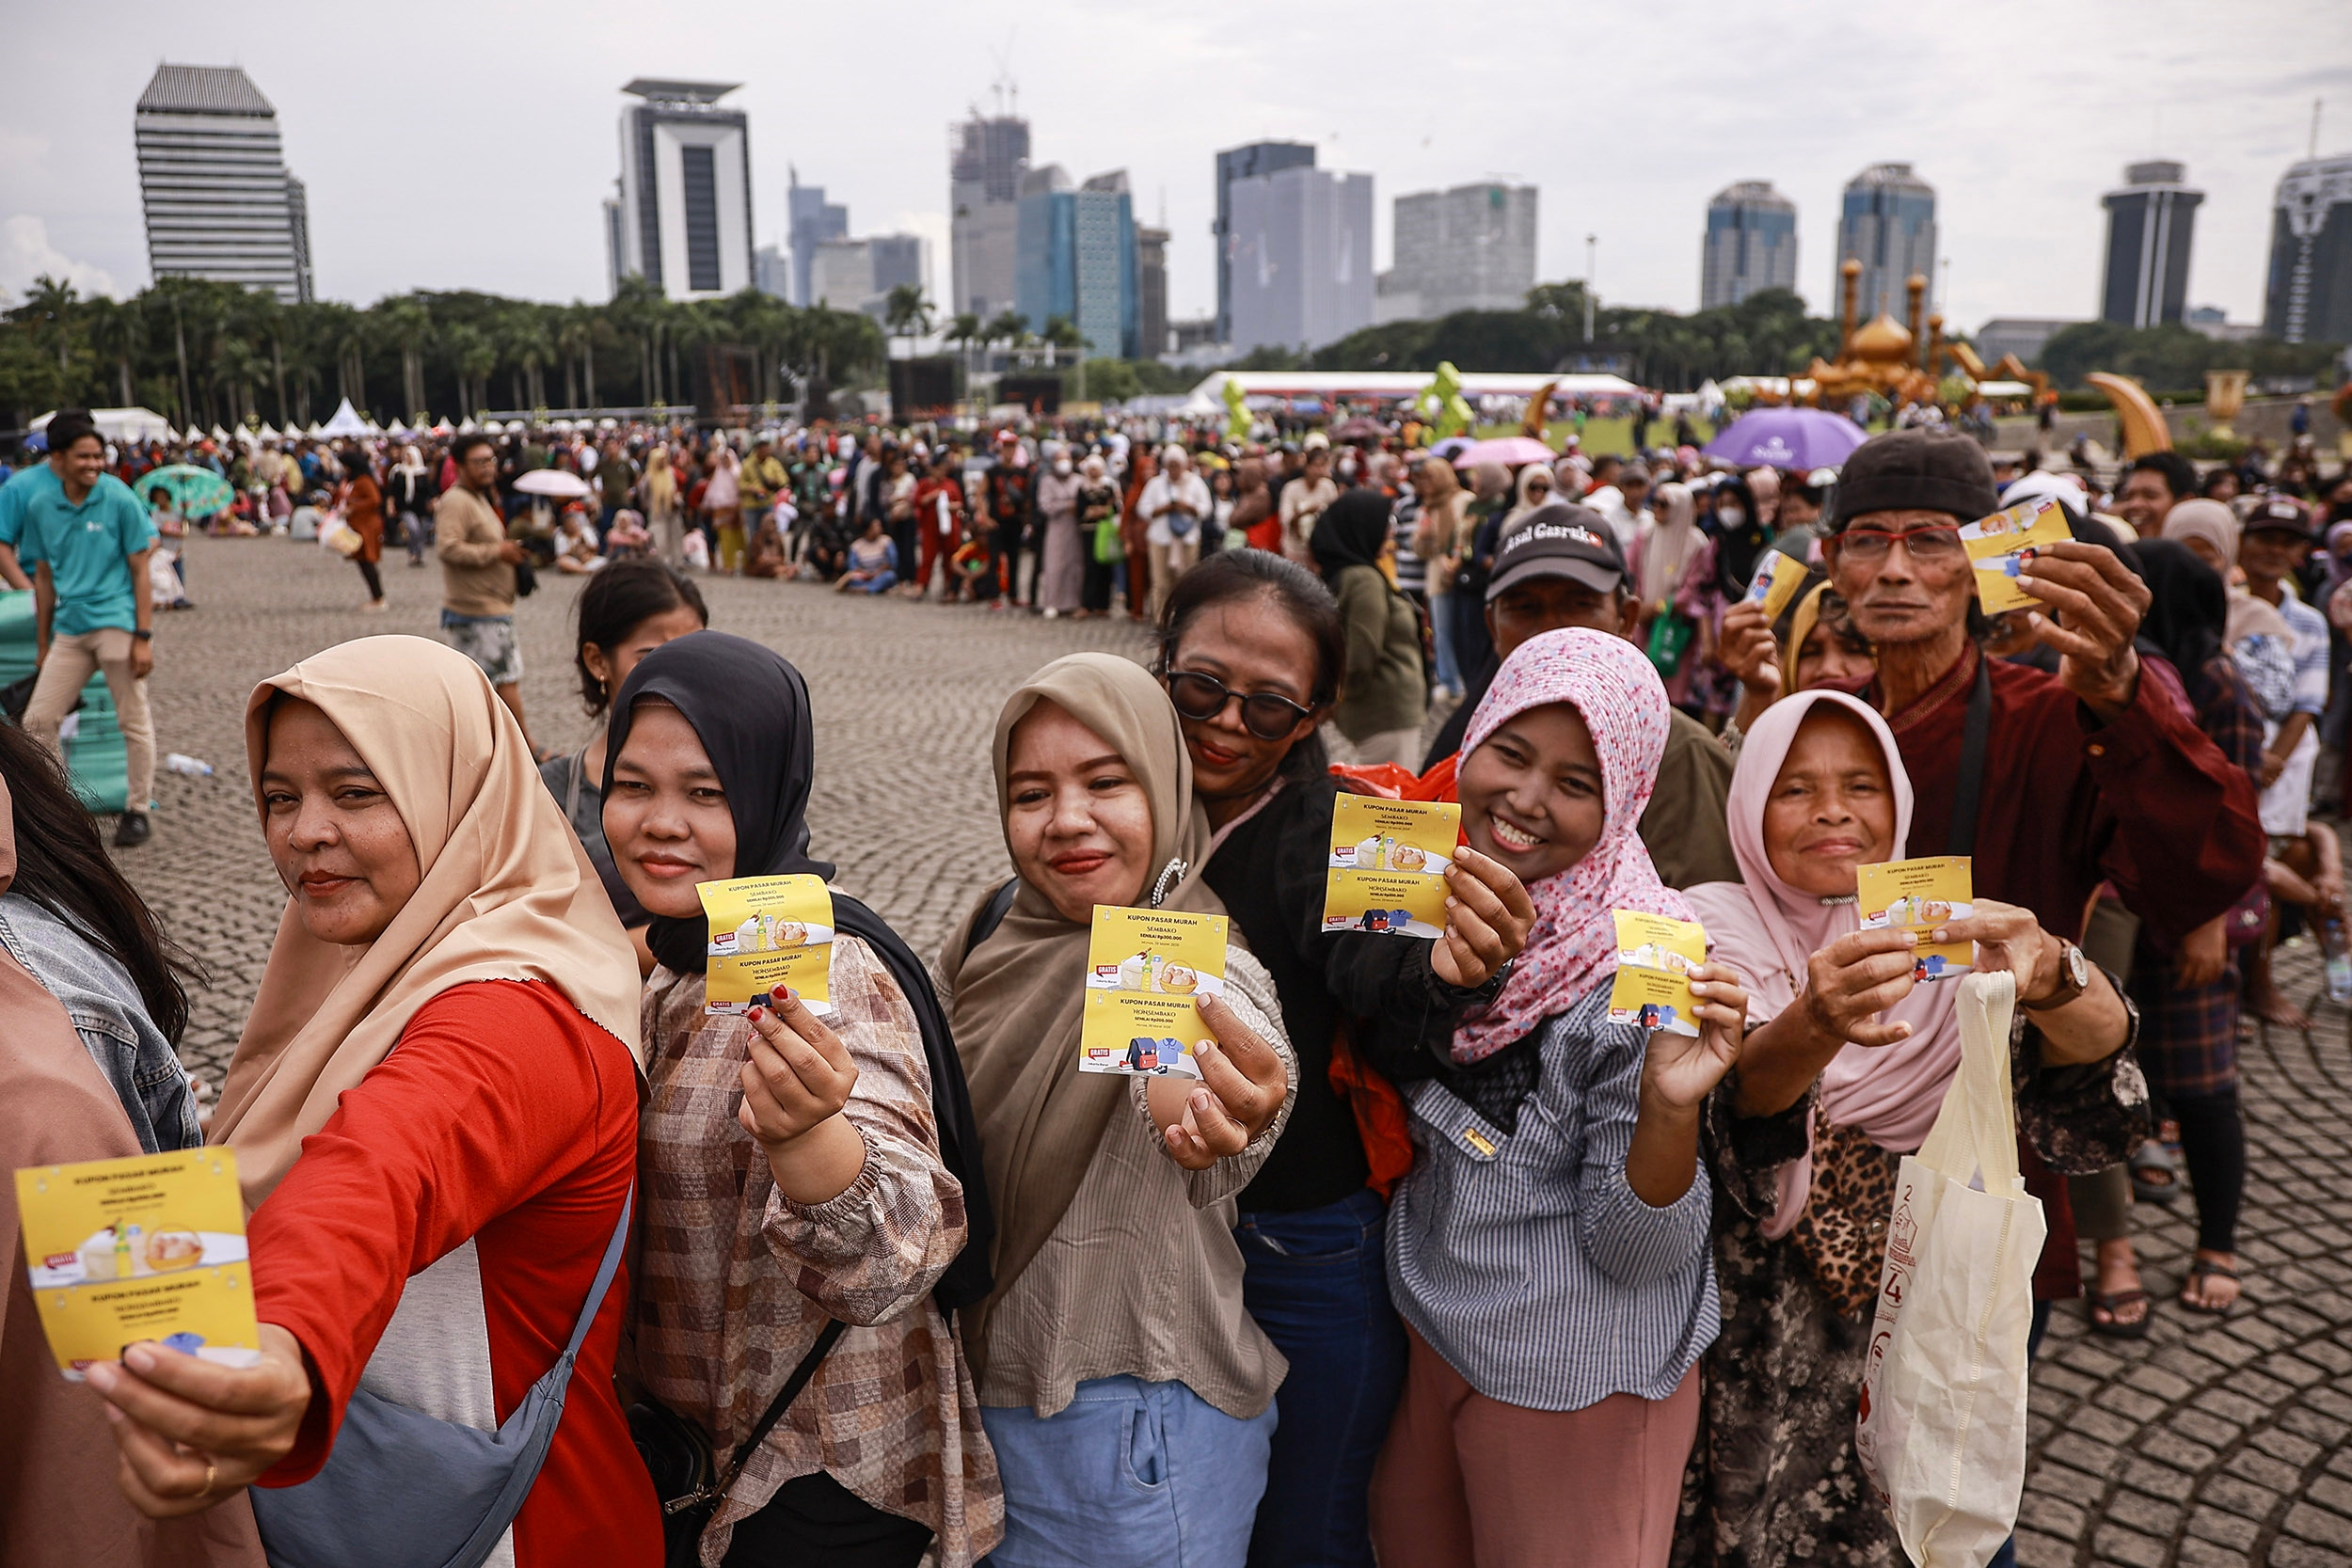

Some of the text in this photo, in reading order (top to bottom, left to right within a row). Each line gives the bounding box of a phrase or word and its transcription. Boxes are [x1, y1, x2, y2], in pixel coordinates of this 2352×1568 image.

[716, 933, 734, 942] GRATIS
[1133, 1008, 1176, 1017] NONSEMBAKO
[1904, 1184, 1913, 1202] 2
[1884, 1273, 1901, 1303] 4
